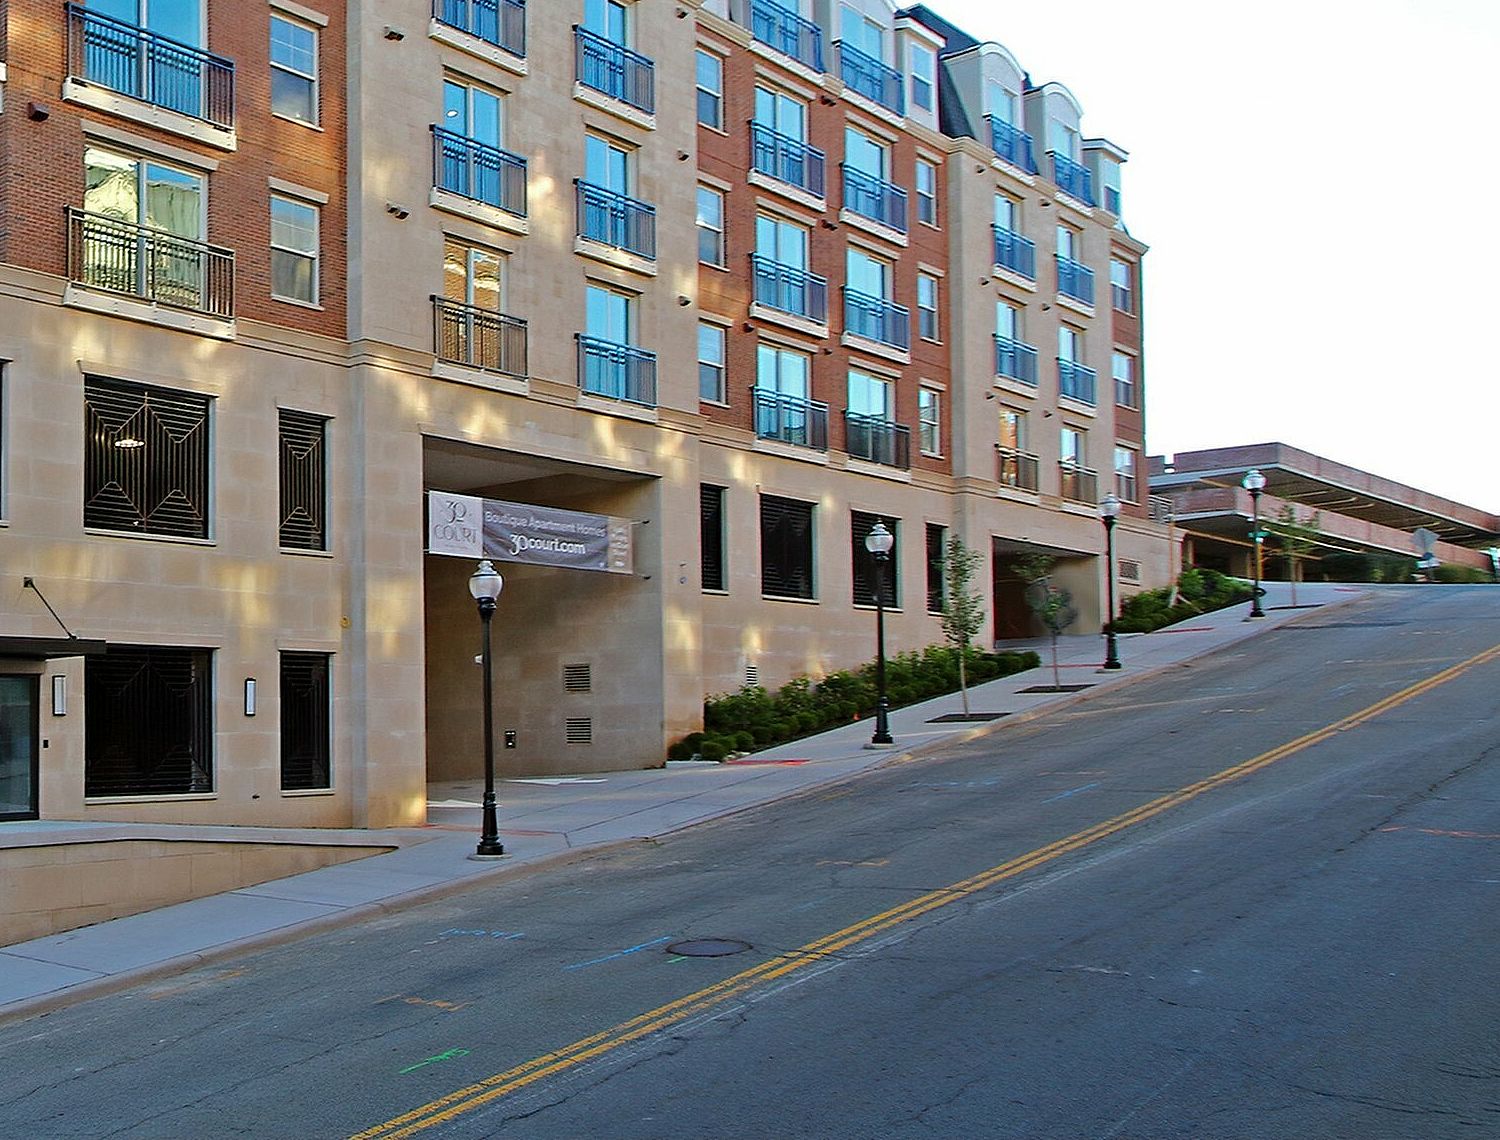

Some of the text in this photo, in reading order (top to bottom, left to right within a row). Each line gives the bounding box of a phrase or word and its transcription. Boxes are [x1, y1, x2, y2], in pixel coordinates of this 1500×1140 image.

[445, 500, 467, 523] 30
[434, 524, 477, 544] COURT
[485, 511, 606, 538] Boutique Apartment Homes
[509, 534, 586, 556] 30court.com
